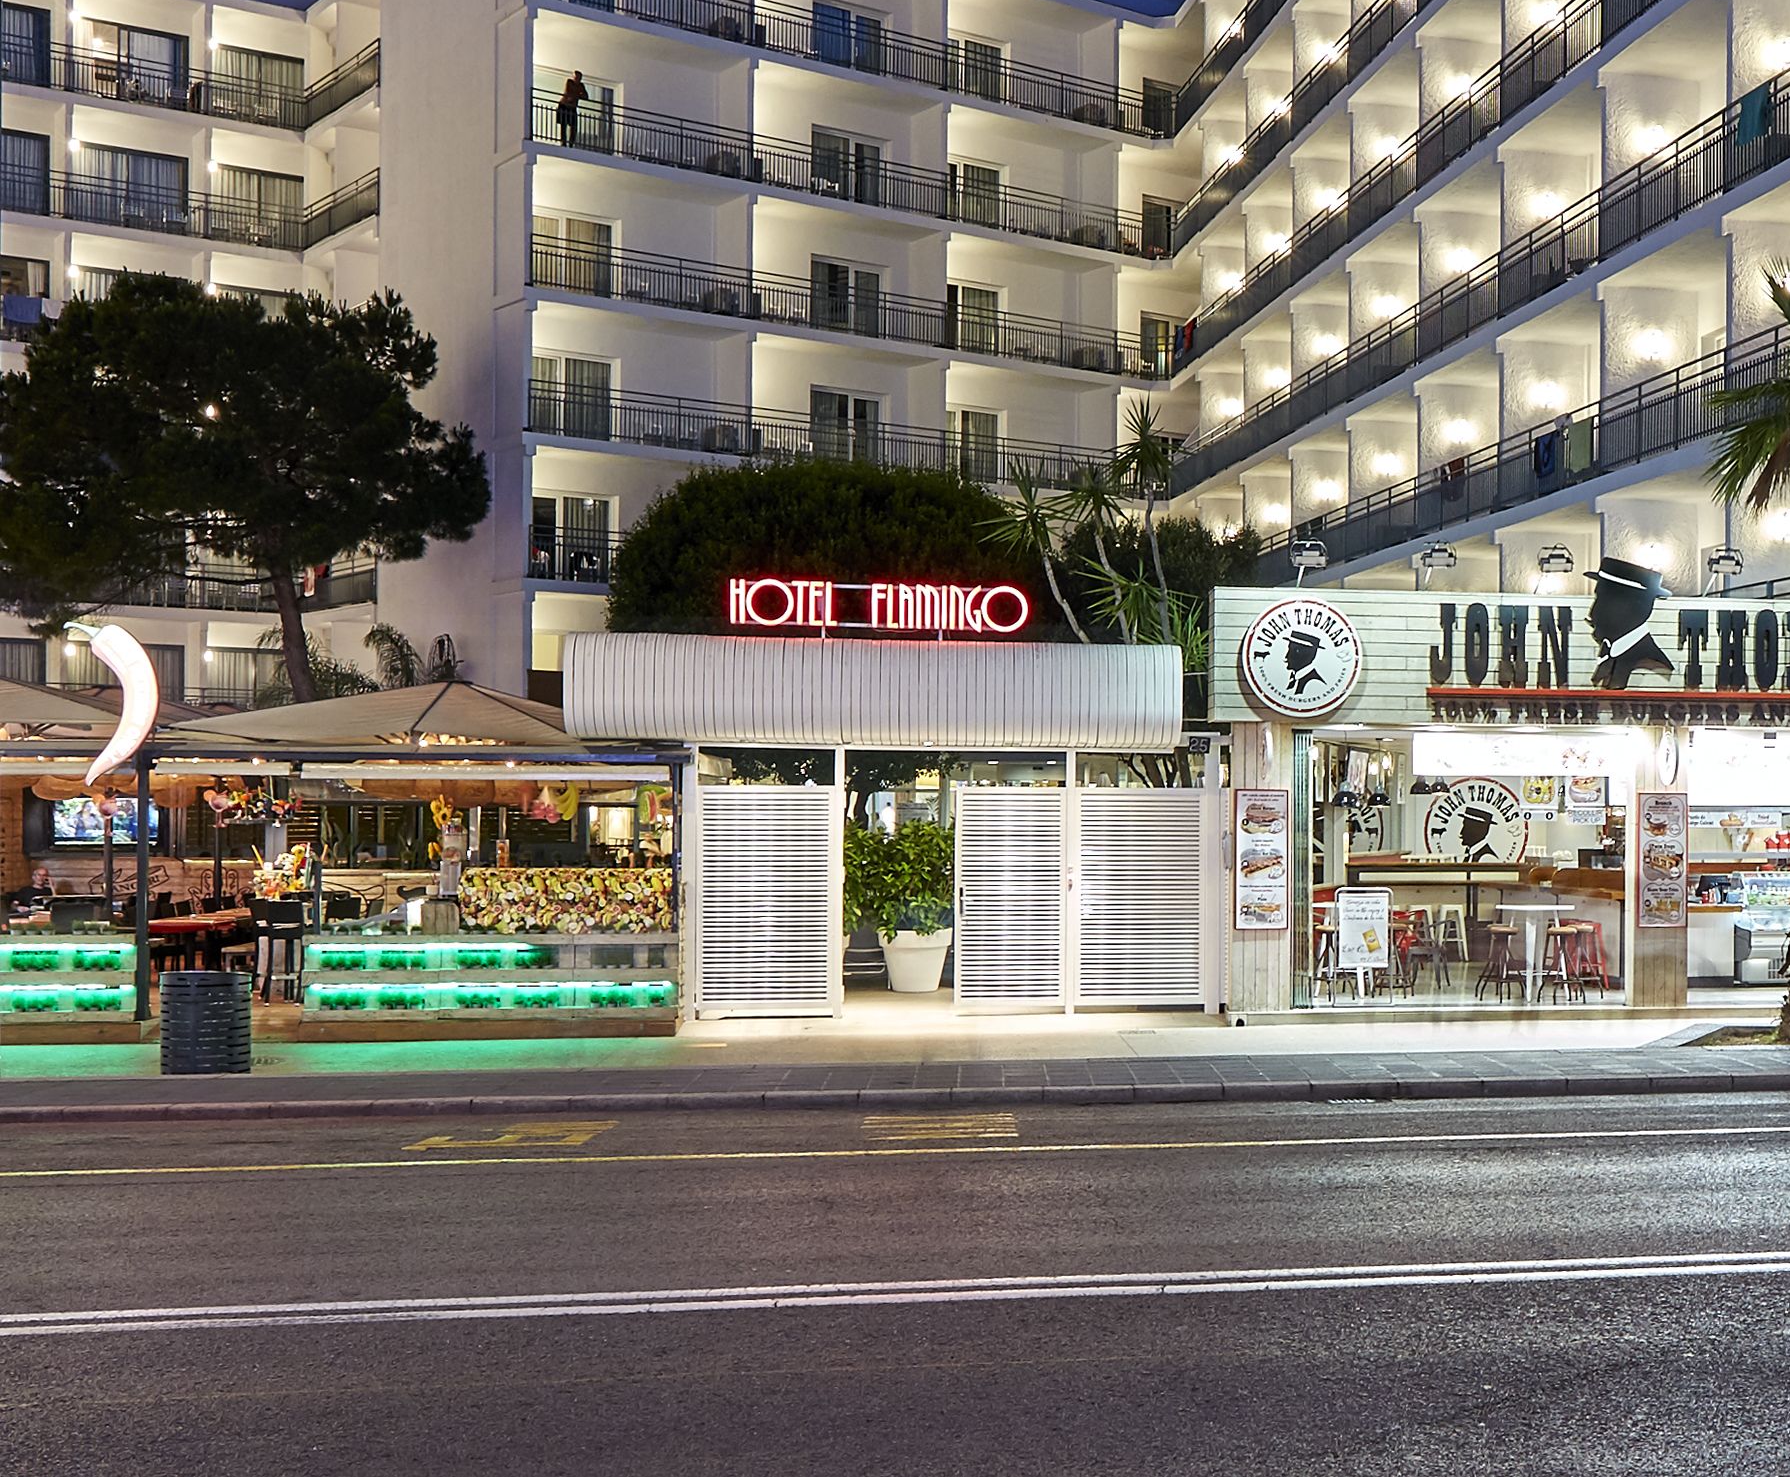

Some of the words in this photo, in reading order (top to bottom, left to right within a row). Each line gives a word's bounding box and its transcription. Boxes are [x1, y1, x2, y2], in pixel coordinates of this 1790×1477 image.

[730, 578, 837, 627] HOTEL
[871, 582, 1029, 633] FLAMINGO
[1257, 612, 1291, 647] JOHN
[1294, 609, 1349, 647] THOMAS
[1429, 602, 1572, 689] JOHN
[1189, 737, 1208, 752] 25
[1434, 789, 1466, 824] JOHN
[1468, 785, 1520, 822] THOMAS
